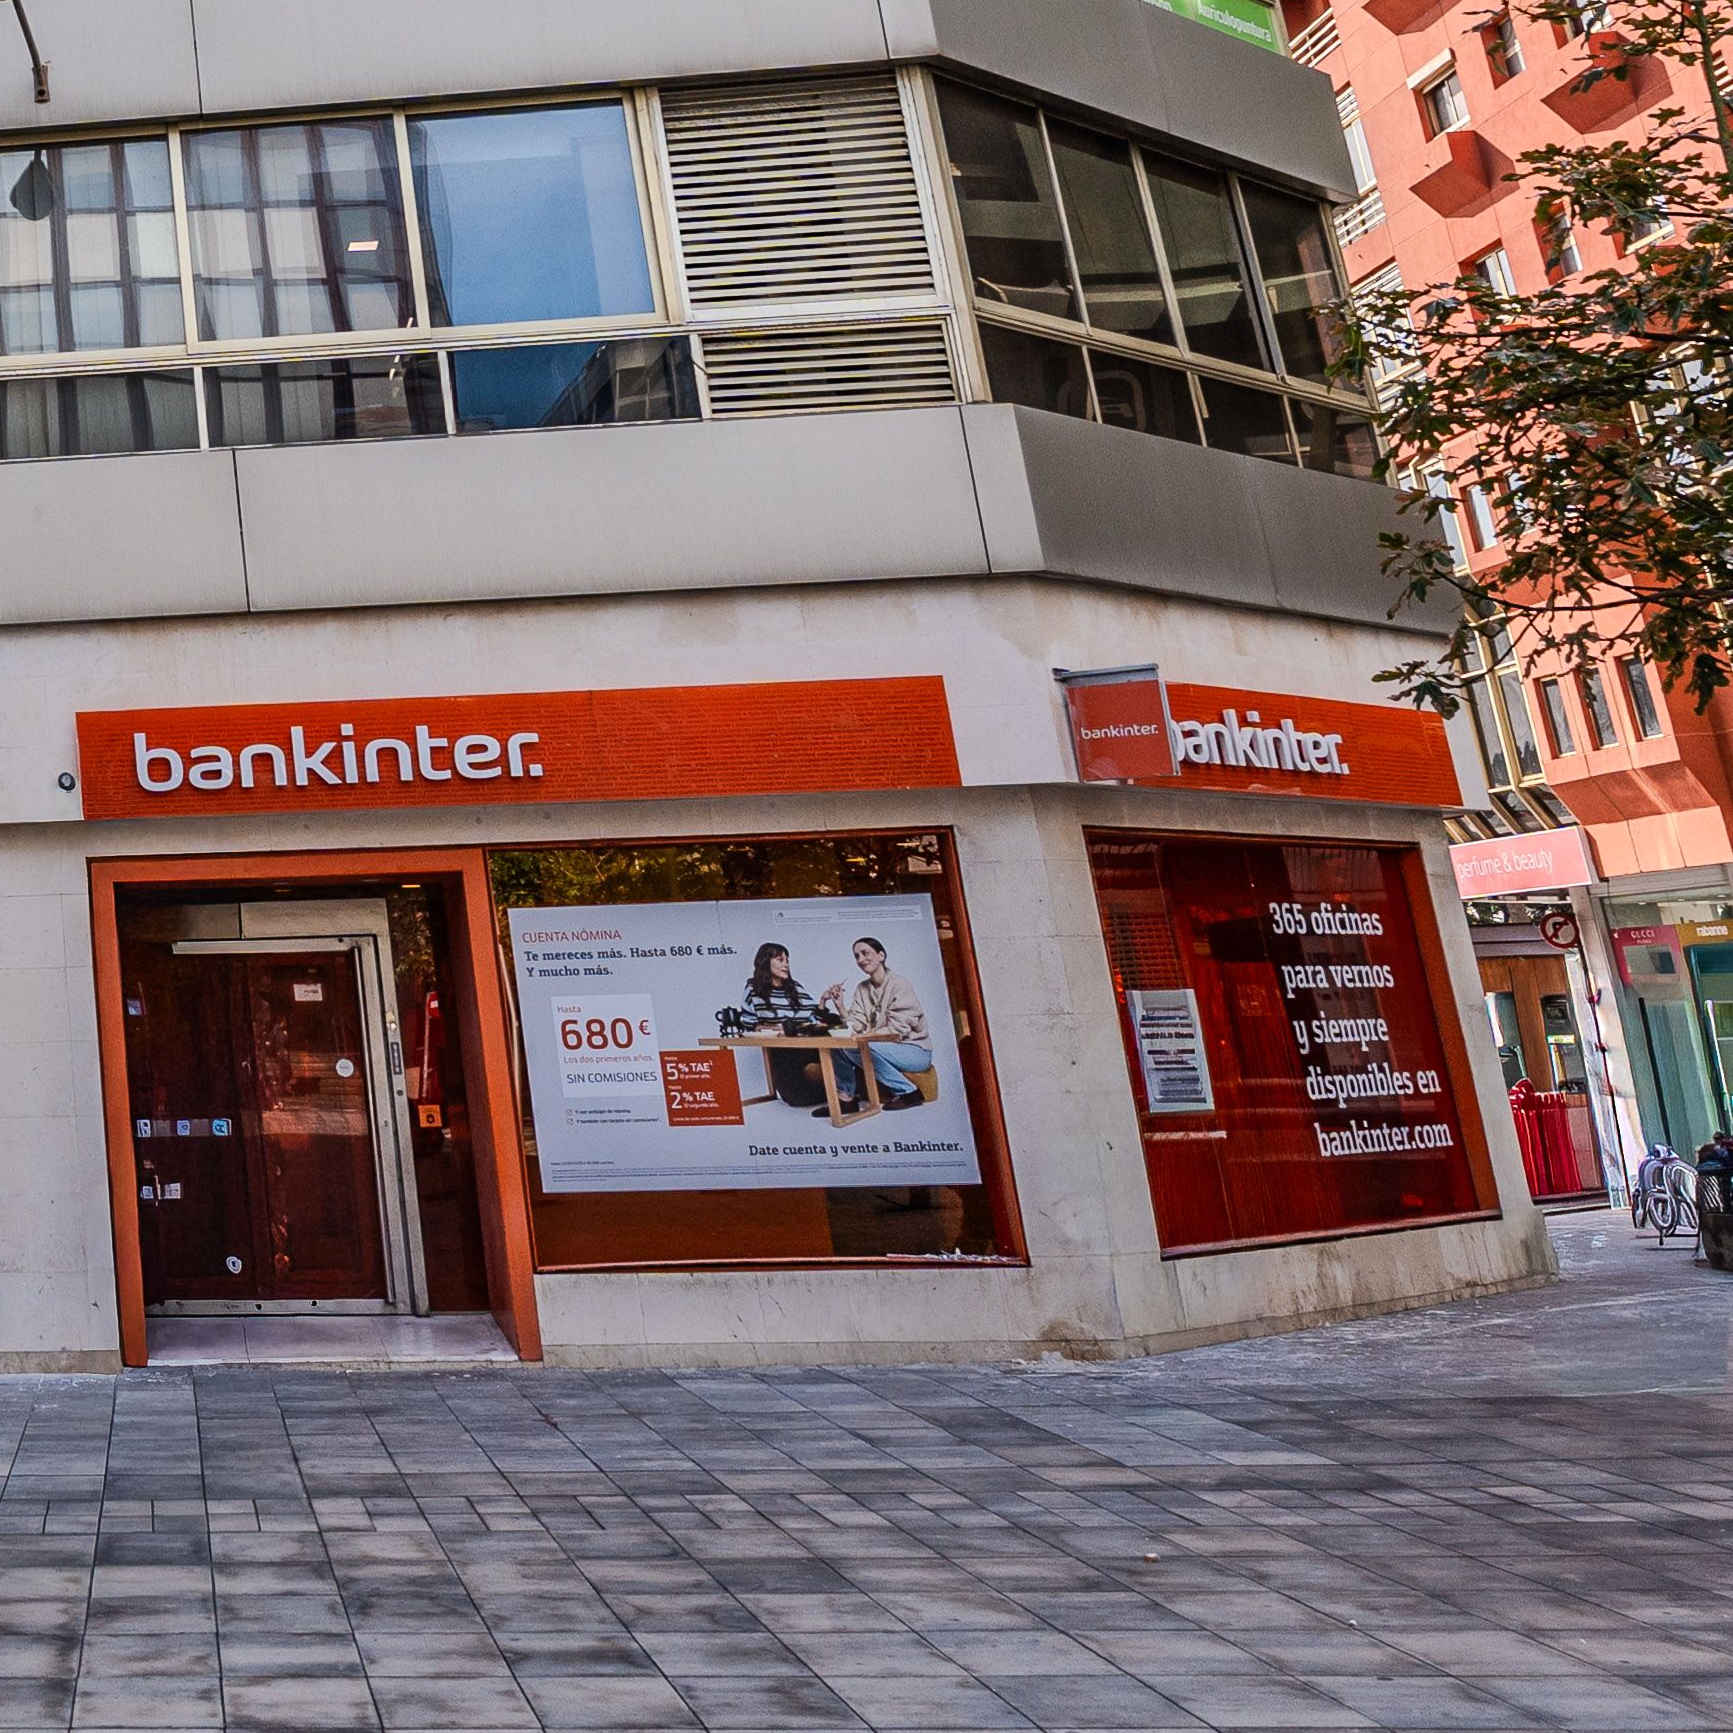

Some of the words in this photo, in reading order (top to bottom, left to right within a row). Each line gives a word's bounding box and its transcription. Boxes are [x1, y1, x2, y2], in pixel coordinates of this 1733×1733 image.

[1197, 0, 1272, 43] Auriculopuntura
[1081, 721, 1159, 740] bankinter.
[133, 724, 543, 793] bankinter.
[1456, 856, 1503, 882] perfume
[1501, 852, 1513, 873] &
[1513, 849, 1553, 874] beauty
[522, 931, 569, 943] CUENTA
[571, 928, 622, 942] NÓMINA
[1268, 902, 1307, 935] 365
[1310, 902, 1383, 936] oficinas
[524, 951, 539, 961] Te
[542, 950, 593, 961] mereces
[597, 948, 627, 960] más.
[629, 947, 667, 958] Hasta
[670, 945, 692, 957] 680
[696, 945, 704, 956] €
[707, 944, 737, 956] más.
[526, 967, 535, 977] Y
[539, 966, 580, 977] mucho
[583, 964, 613, 976] más.
[1281, 962, 1329, 999] para
[1329, 963, 1395, 989] vernos
[560, 1017, 633, 1050] 680
[638, 1019, 651, 1036] €
[1293, 1020, 1309, 1055] y
[1312, 1012, 1389, 1052] siempre
[564, 1055, 578, 1064] Los
[579, 1055, 594, 1063] dos
[596, 1054, 632, 1064] primeros
[567, 1073, 585, 1084] SIN
[587, 1072, 658, 1083] COMISIONES
[1306, 1063, 1414, 1109] disponibles
[1418, 1068, 1441, 1093] en
[694, 1091, 716, 1101] TAE
[749, 1144, 779, 1156] Date
[782, 1144, 827, 1156] cuenta
[829, 1145, 838, 1157] y
[841, 1143, 878, 1154] vente
[882, 1144, 891, 1153] a
[893, 1140, 964, 1153] Bankinter.
[1314, 1120, 1453, 1157] bankinter.com
